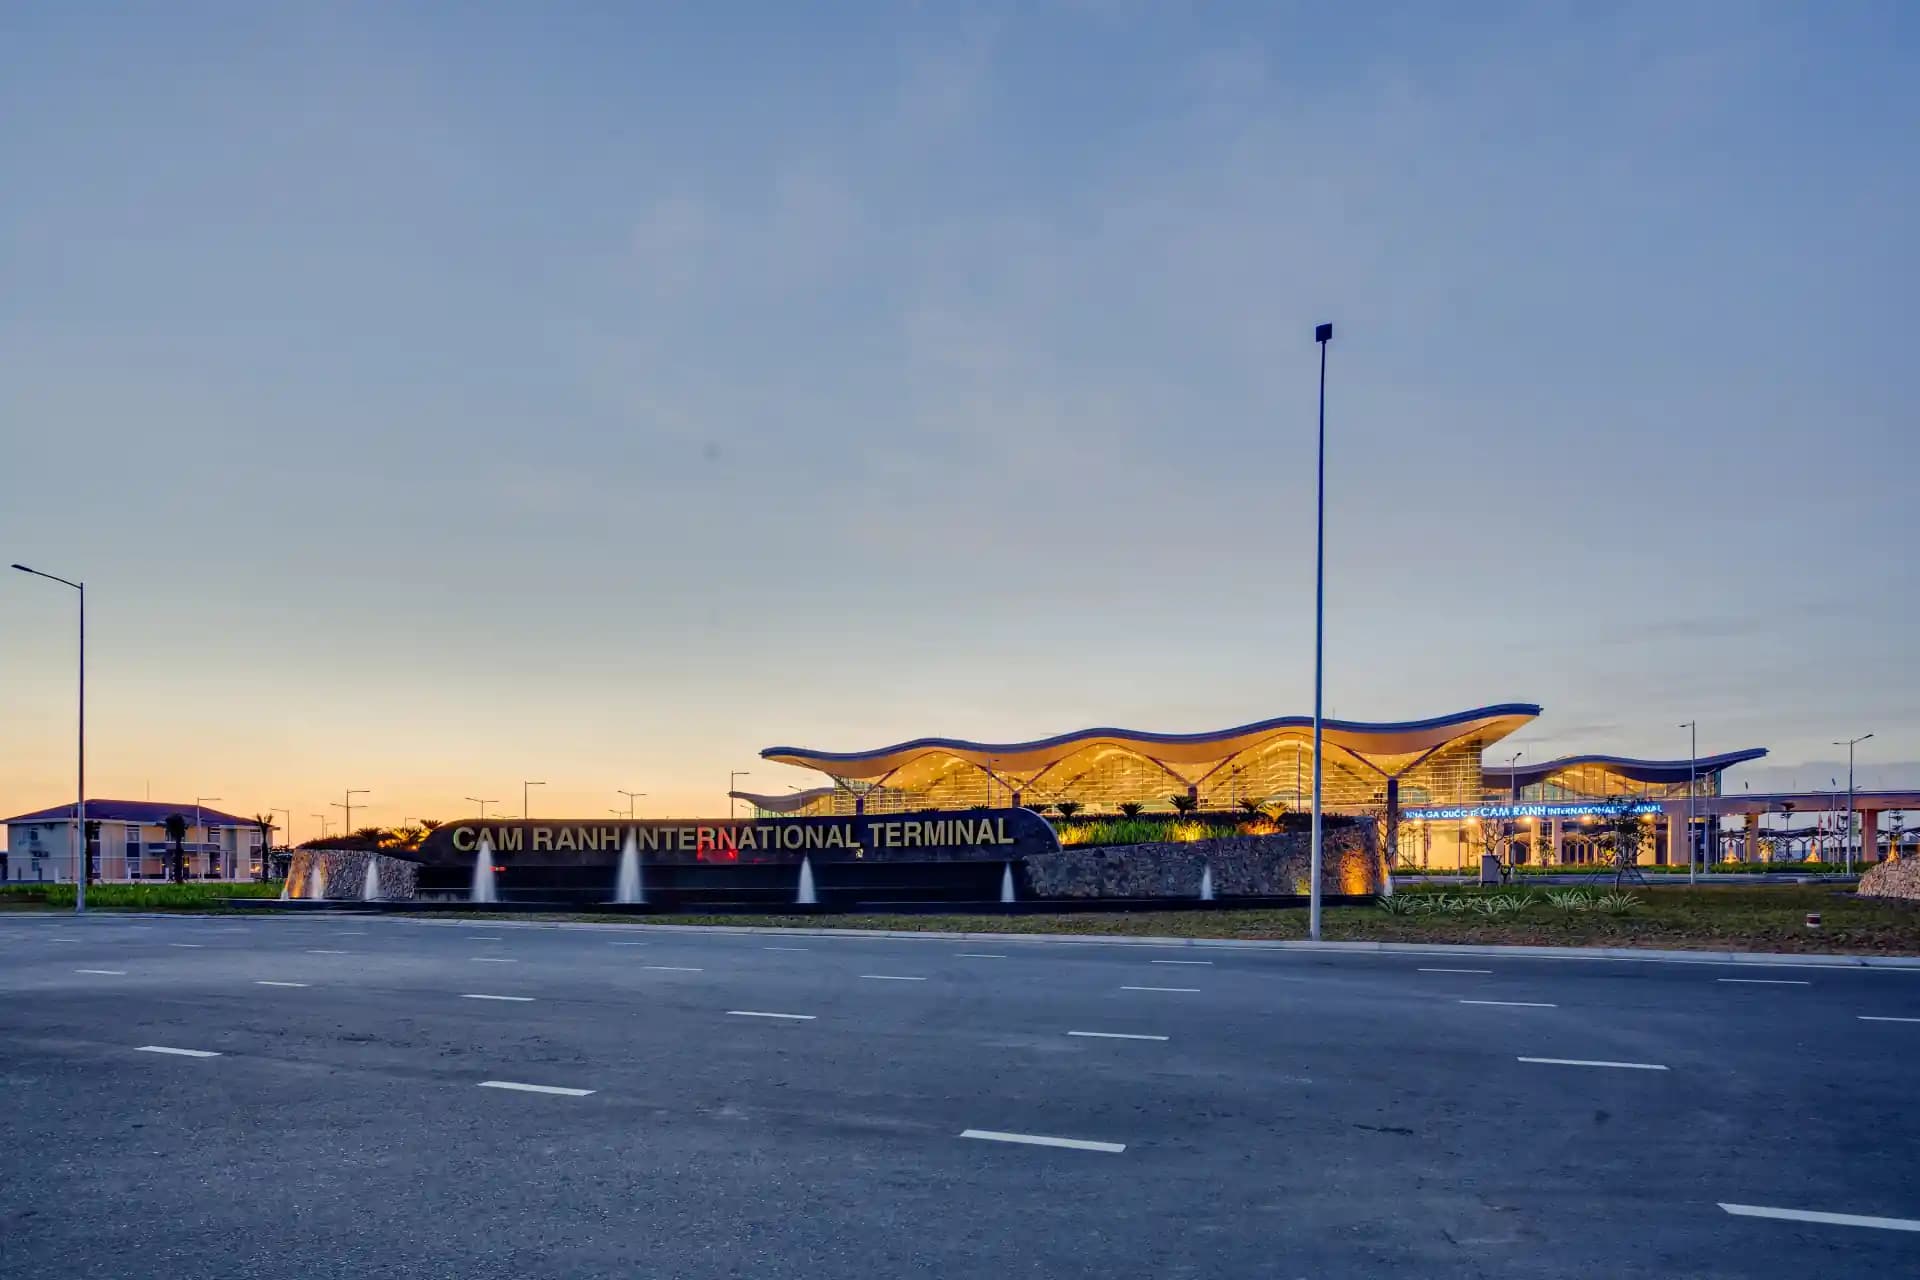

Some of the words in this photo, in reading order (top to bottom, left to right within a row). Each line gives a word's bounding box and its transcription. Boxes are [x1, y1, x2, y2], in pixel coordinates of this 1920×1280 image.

[1426, 810, 1440, 818] GA
[1480, 807, 1510, 817] CAM
[1513, 805, 1547, 816] RANH
[453, 826, 523, 851] CAM
[533, 826, 620, 851] RANH
[630, 823, 861, 851] INTERNATIONAL
[868, 818, 1014, 848] TERMINAL
